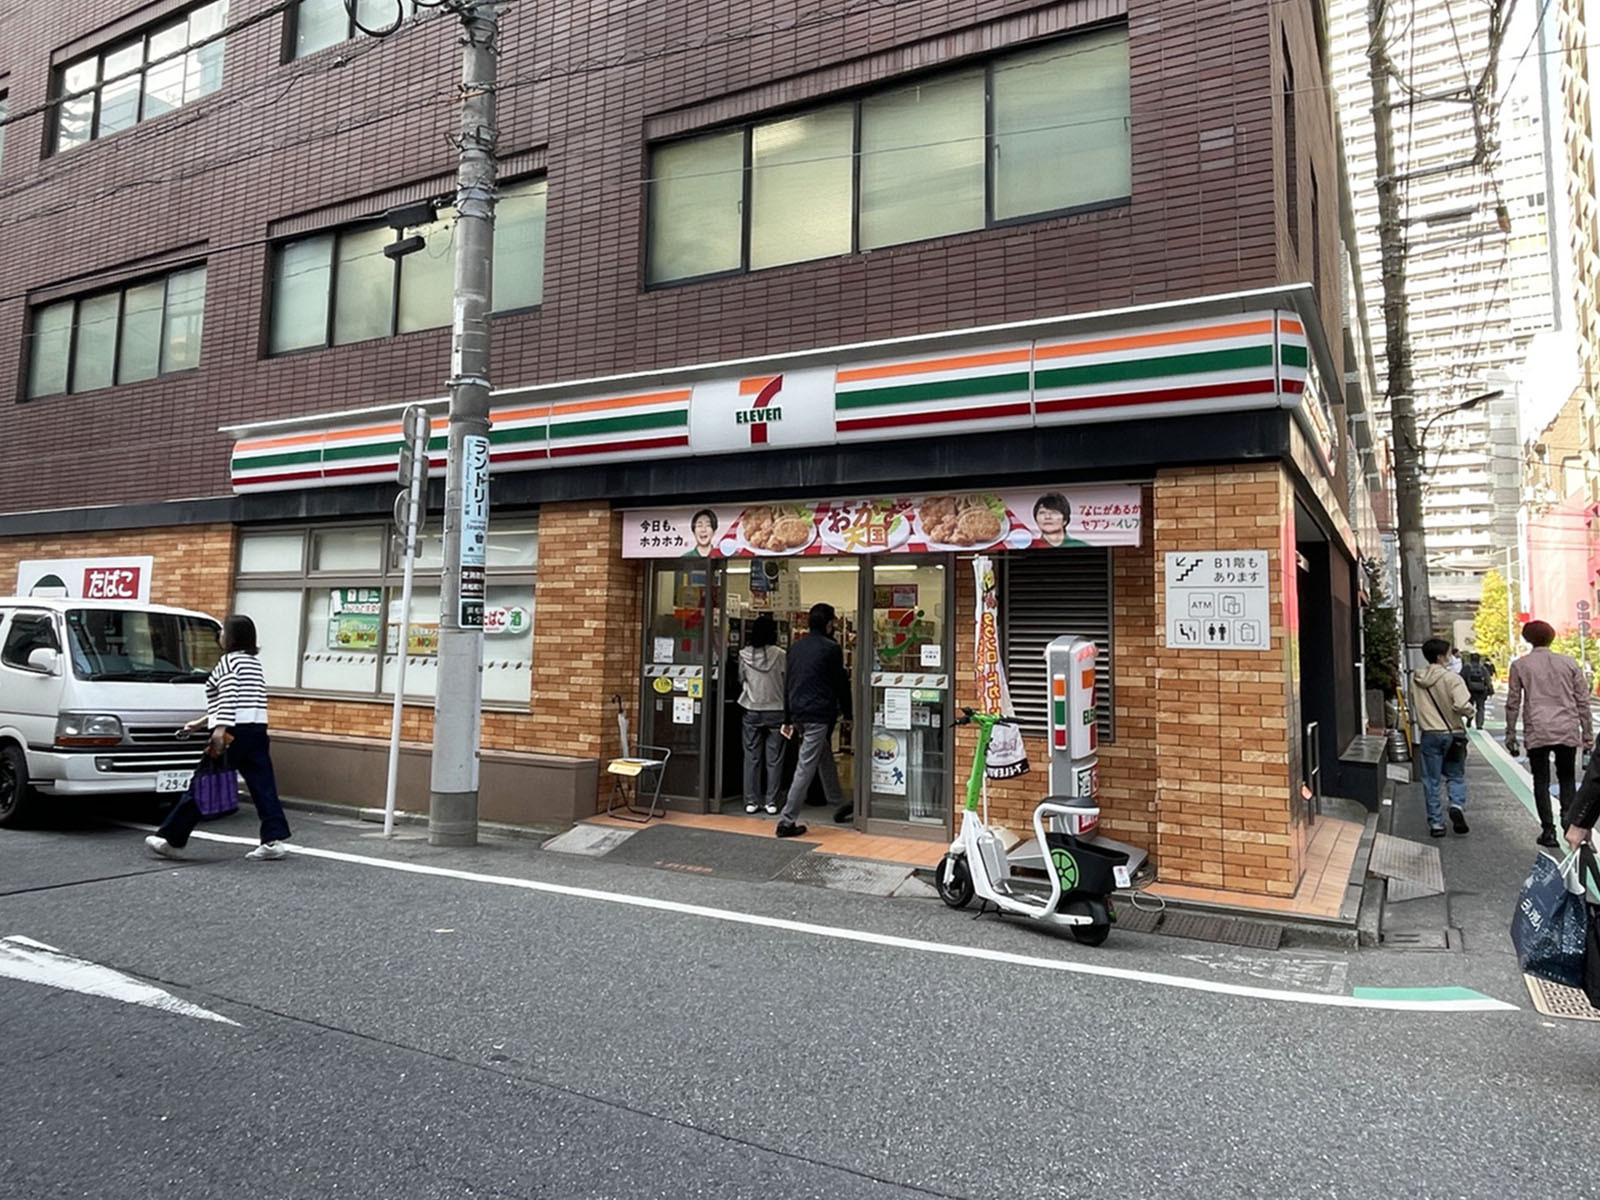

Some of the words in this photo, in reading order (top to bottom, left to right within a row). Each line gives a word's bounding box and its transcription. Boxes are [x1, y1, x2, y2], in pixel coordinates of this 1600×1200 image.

[640, 520, 676, 532] 今日も、
[88, 569, 134, 598] たばこ
[1214, 572, 1259, 583] あります
[1191, 601, 1213, 609] ATM
[510, 610, 522, 627] 酒
